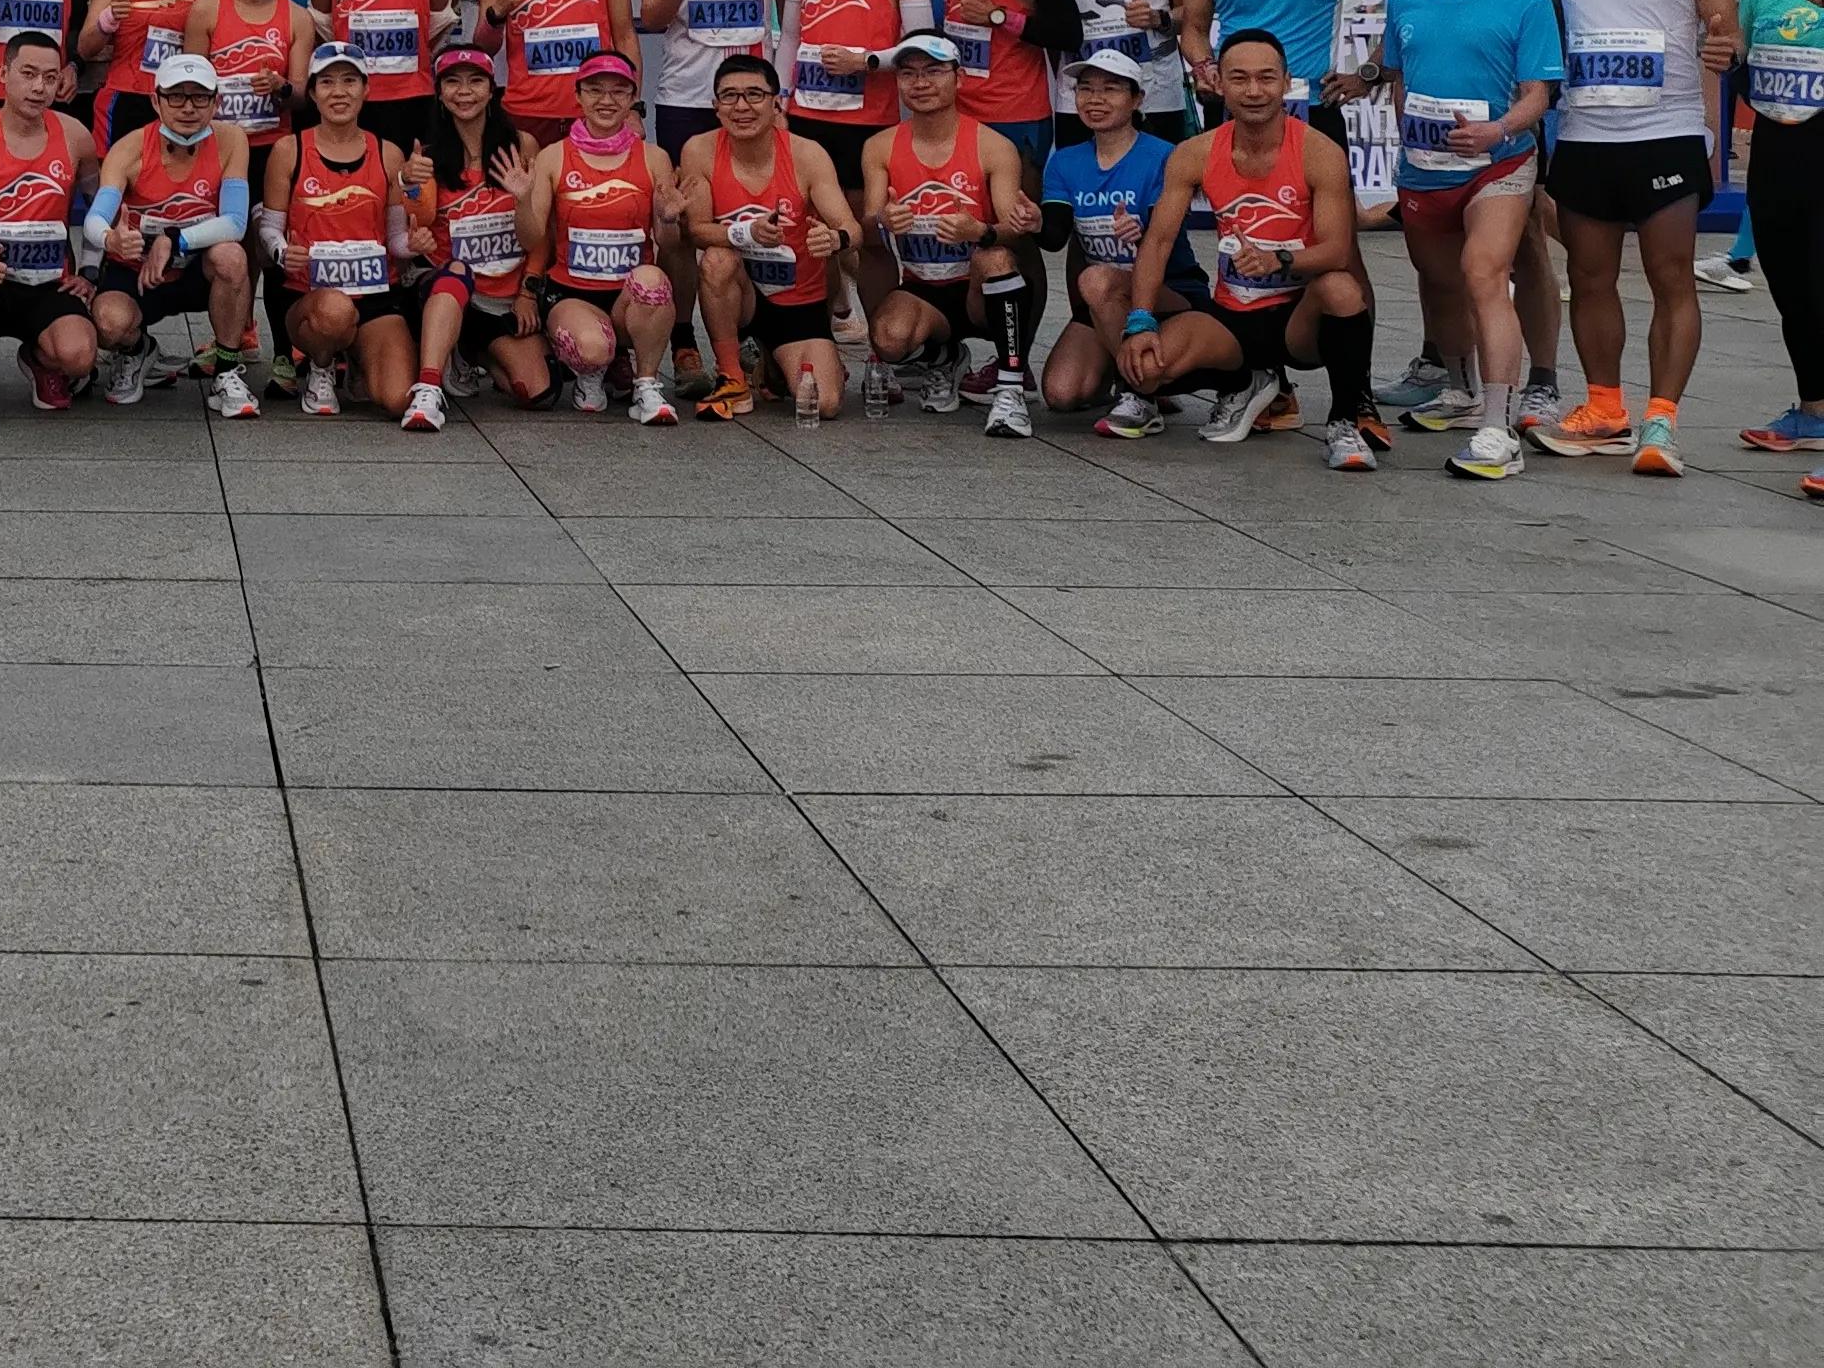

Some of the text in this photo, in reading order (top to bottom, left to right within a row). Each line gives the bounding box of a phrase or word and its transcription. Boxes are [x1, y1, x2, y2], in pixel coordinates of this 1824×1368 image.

[0, 1, 61, 24] A10063
[695, 2, 757, 24] A11213
[1572, 54, 1655, 81] A13288
[1754, 73, 1824, 100] A20216
[1074, 190, 1136, 207] HONOR
[572, 244, 641, 269] A20043
[315, 257, 383, 283] A20153
